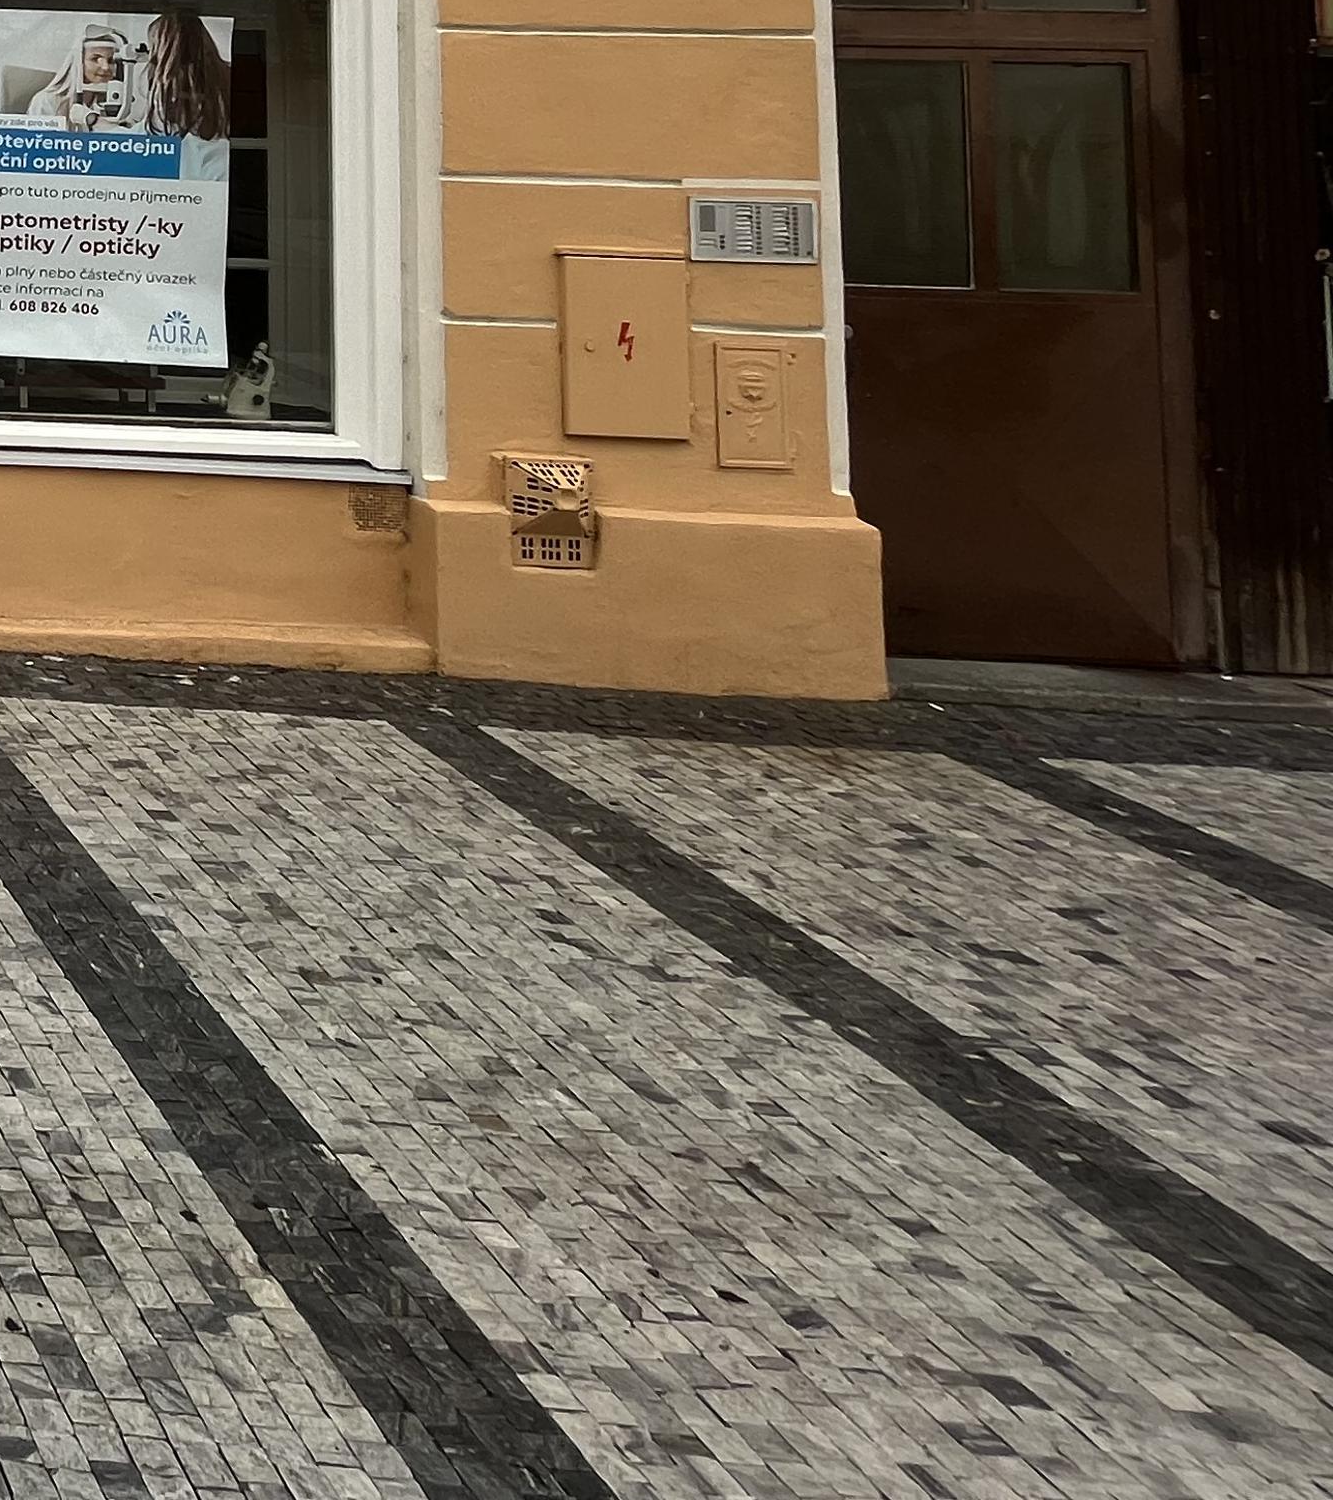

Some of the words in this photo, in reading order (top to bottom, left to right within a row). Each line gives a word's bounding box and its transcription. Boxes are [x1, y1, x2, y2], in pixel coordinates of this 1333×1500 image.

[88, 138, 175, 157] prodejnu
[33, 154, 93, 173] optiky
[0, 186, 24, 198] pro
[27, 185, 59, 198] tuto
[63, 188, 126, 202] prodejnu
[135, 214, 183, 238] /-ky
[61, 234, 73, 254] /
[79, 236, 161, 260] optičky
[5, 266, 35, 280] plný
[39, 266, 76, 280] nebo
[79, 268, 143, 284] částečný
[146, 271, 197, 286] úvazek
[15, 283, 83, 297] informací
[87, 287, 104, 298] na
[9, 300, 36, 312] 608
[41, 301, 67, 314] 826
[71, 302, 99, 315] 406
[147, 324, 209, 346] AURA
